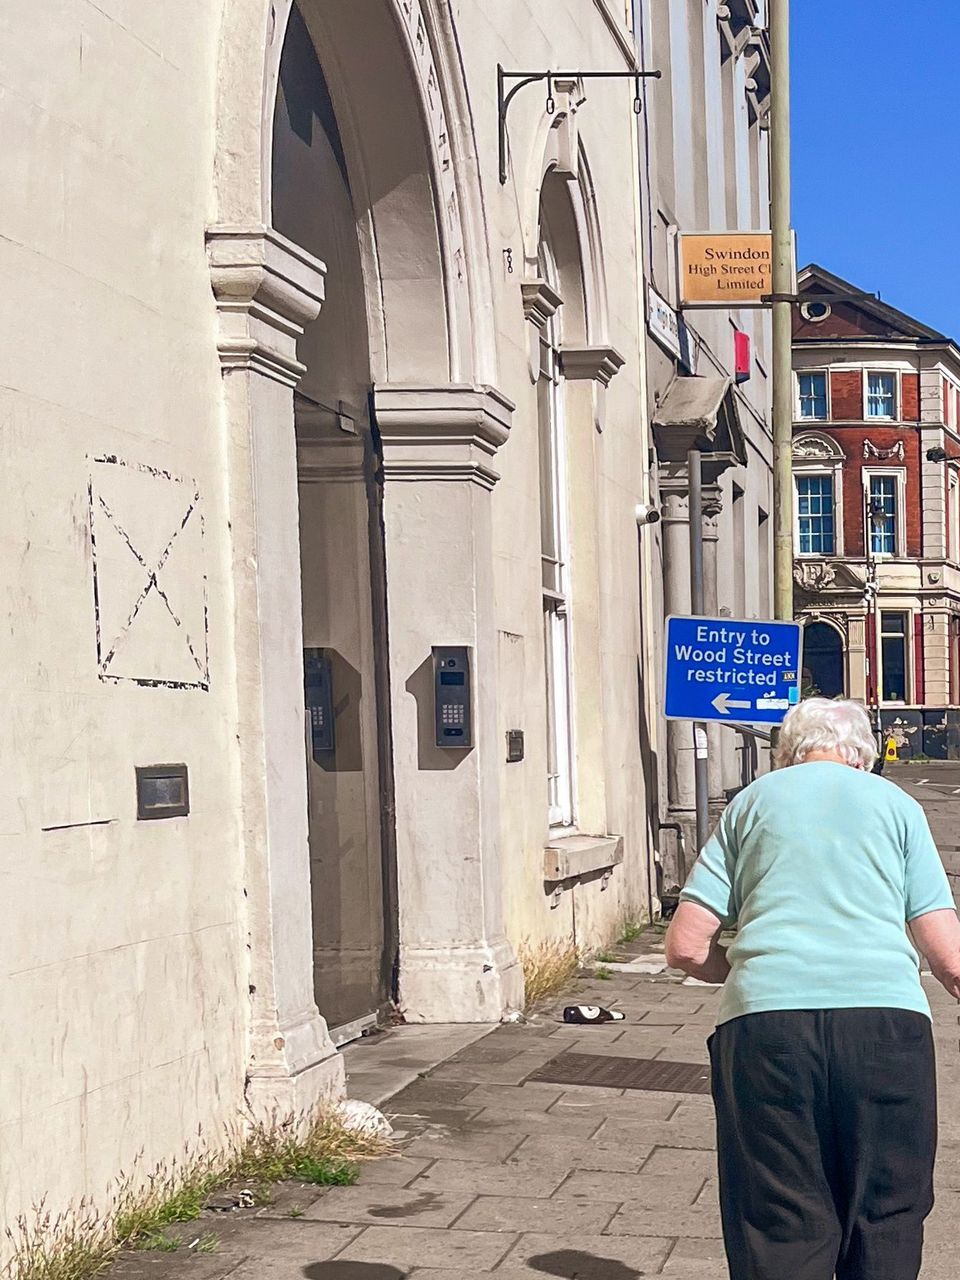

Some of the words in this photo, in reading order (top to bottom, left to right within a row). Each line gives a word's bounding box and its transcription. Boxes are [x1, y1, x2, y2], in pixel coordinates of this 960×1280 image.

[704, 247, 770, 260] Swindon
[688, 263, 717, 277] High
[720, 264, 754, 275] Street
[758, 263, 772, 275] Cl
[717, 278, 764, 290] Limited
[697, 626, 746, 647] Entry
[751, 629, 770, 646] to
[674, 644, 726, 663] Wood
[733, 648, 791, 667] Street
[687, 667, 777, 686] restricted
